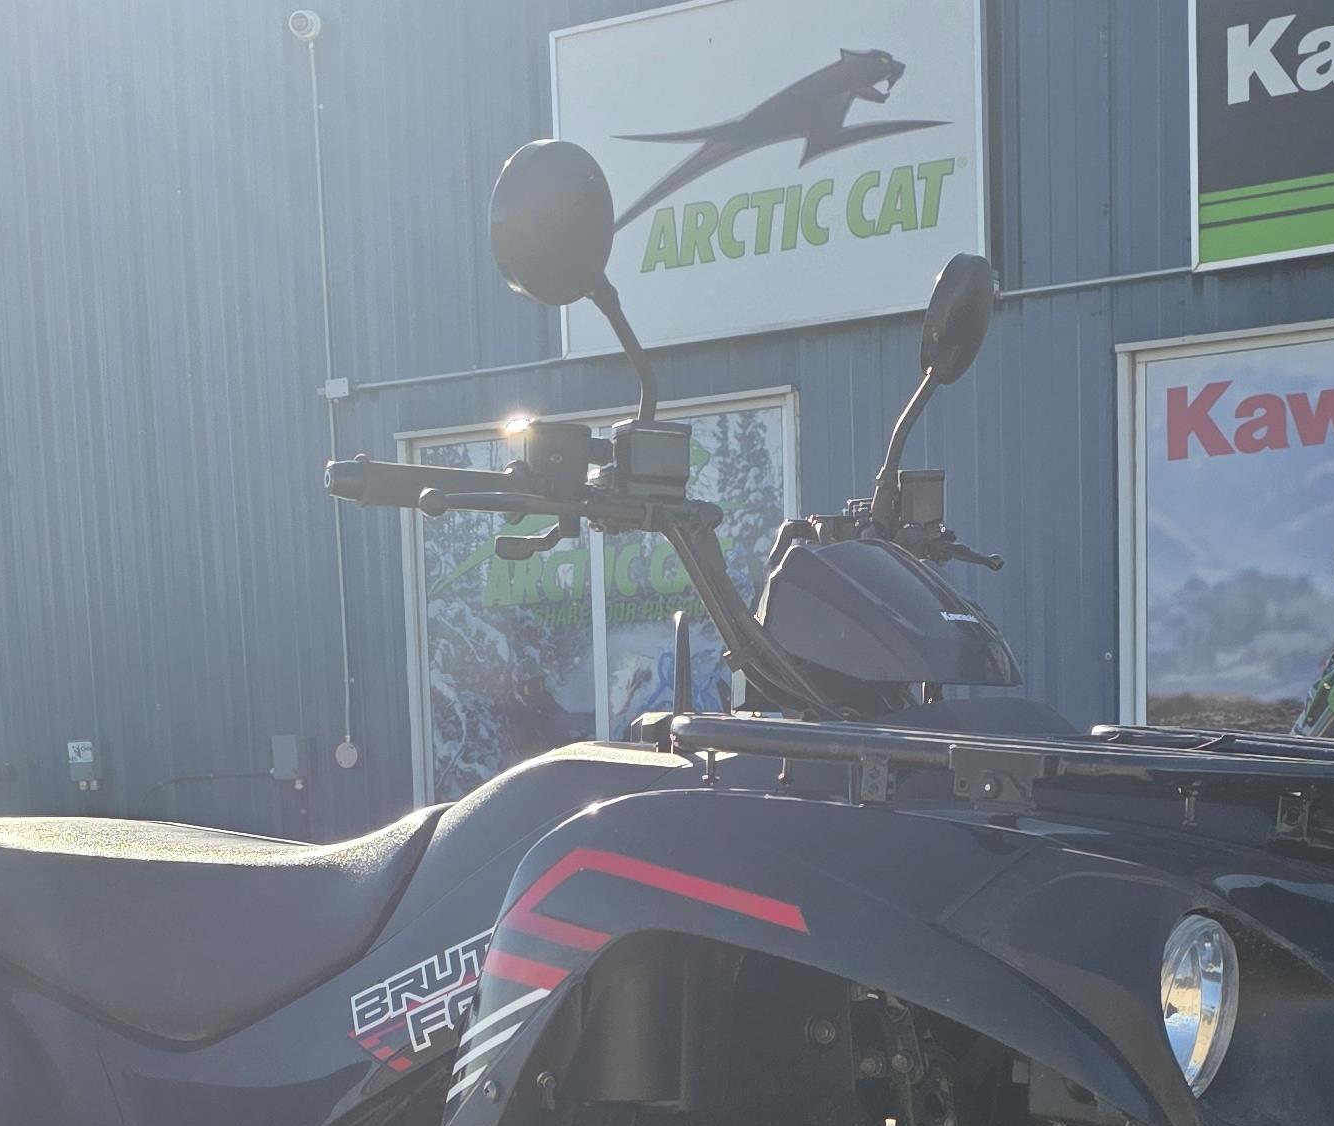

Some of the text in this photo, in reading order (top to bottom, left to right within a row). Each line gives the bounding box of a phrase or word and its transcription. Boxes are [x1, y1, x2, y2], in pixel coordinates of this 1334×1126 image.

[640, 158, 955, 273] ARCTIC CAT
[534, 605, 591, 628] SHARE
